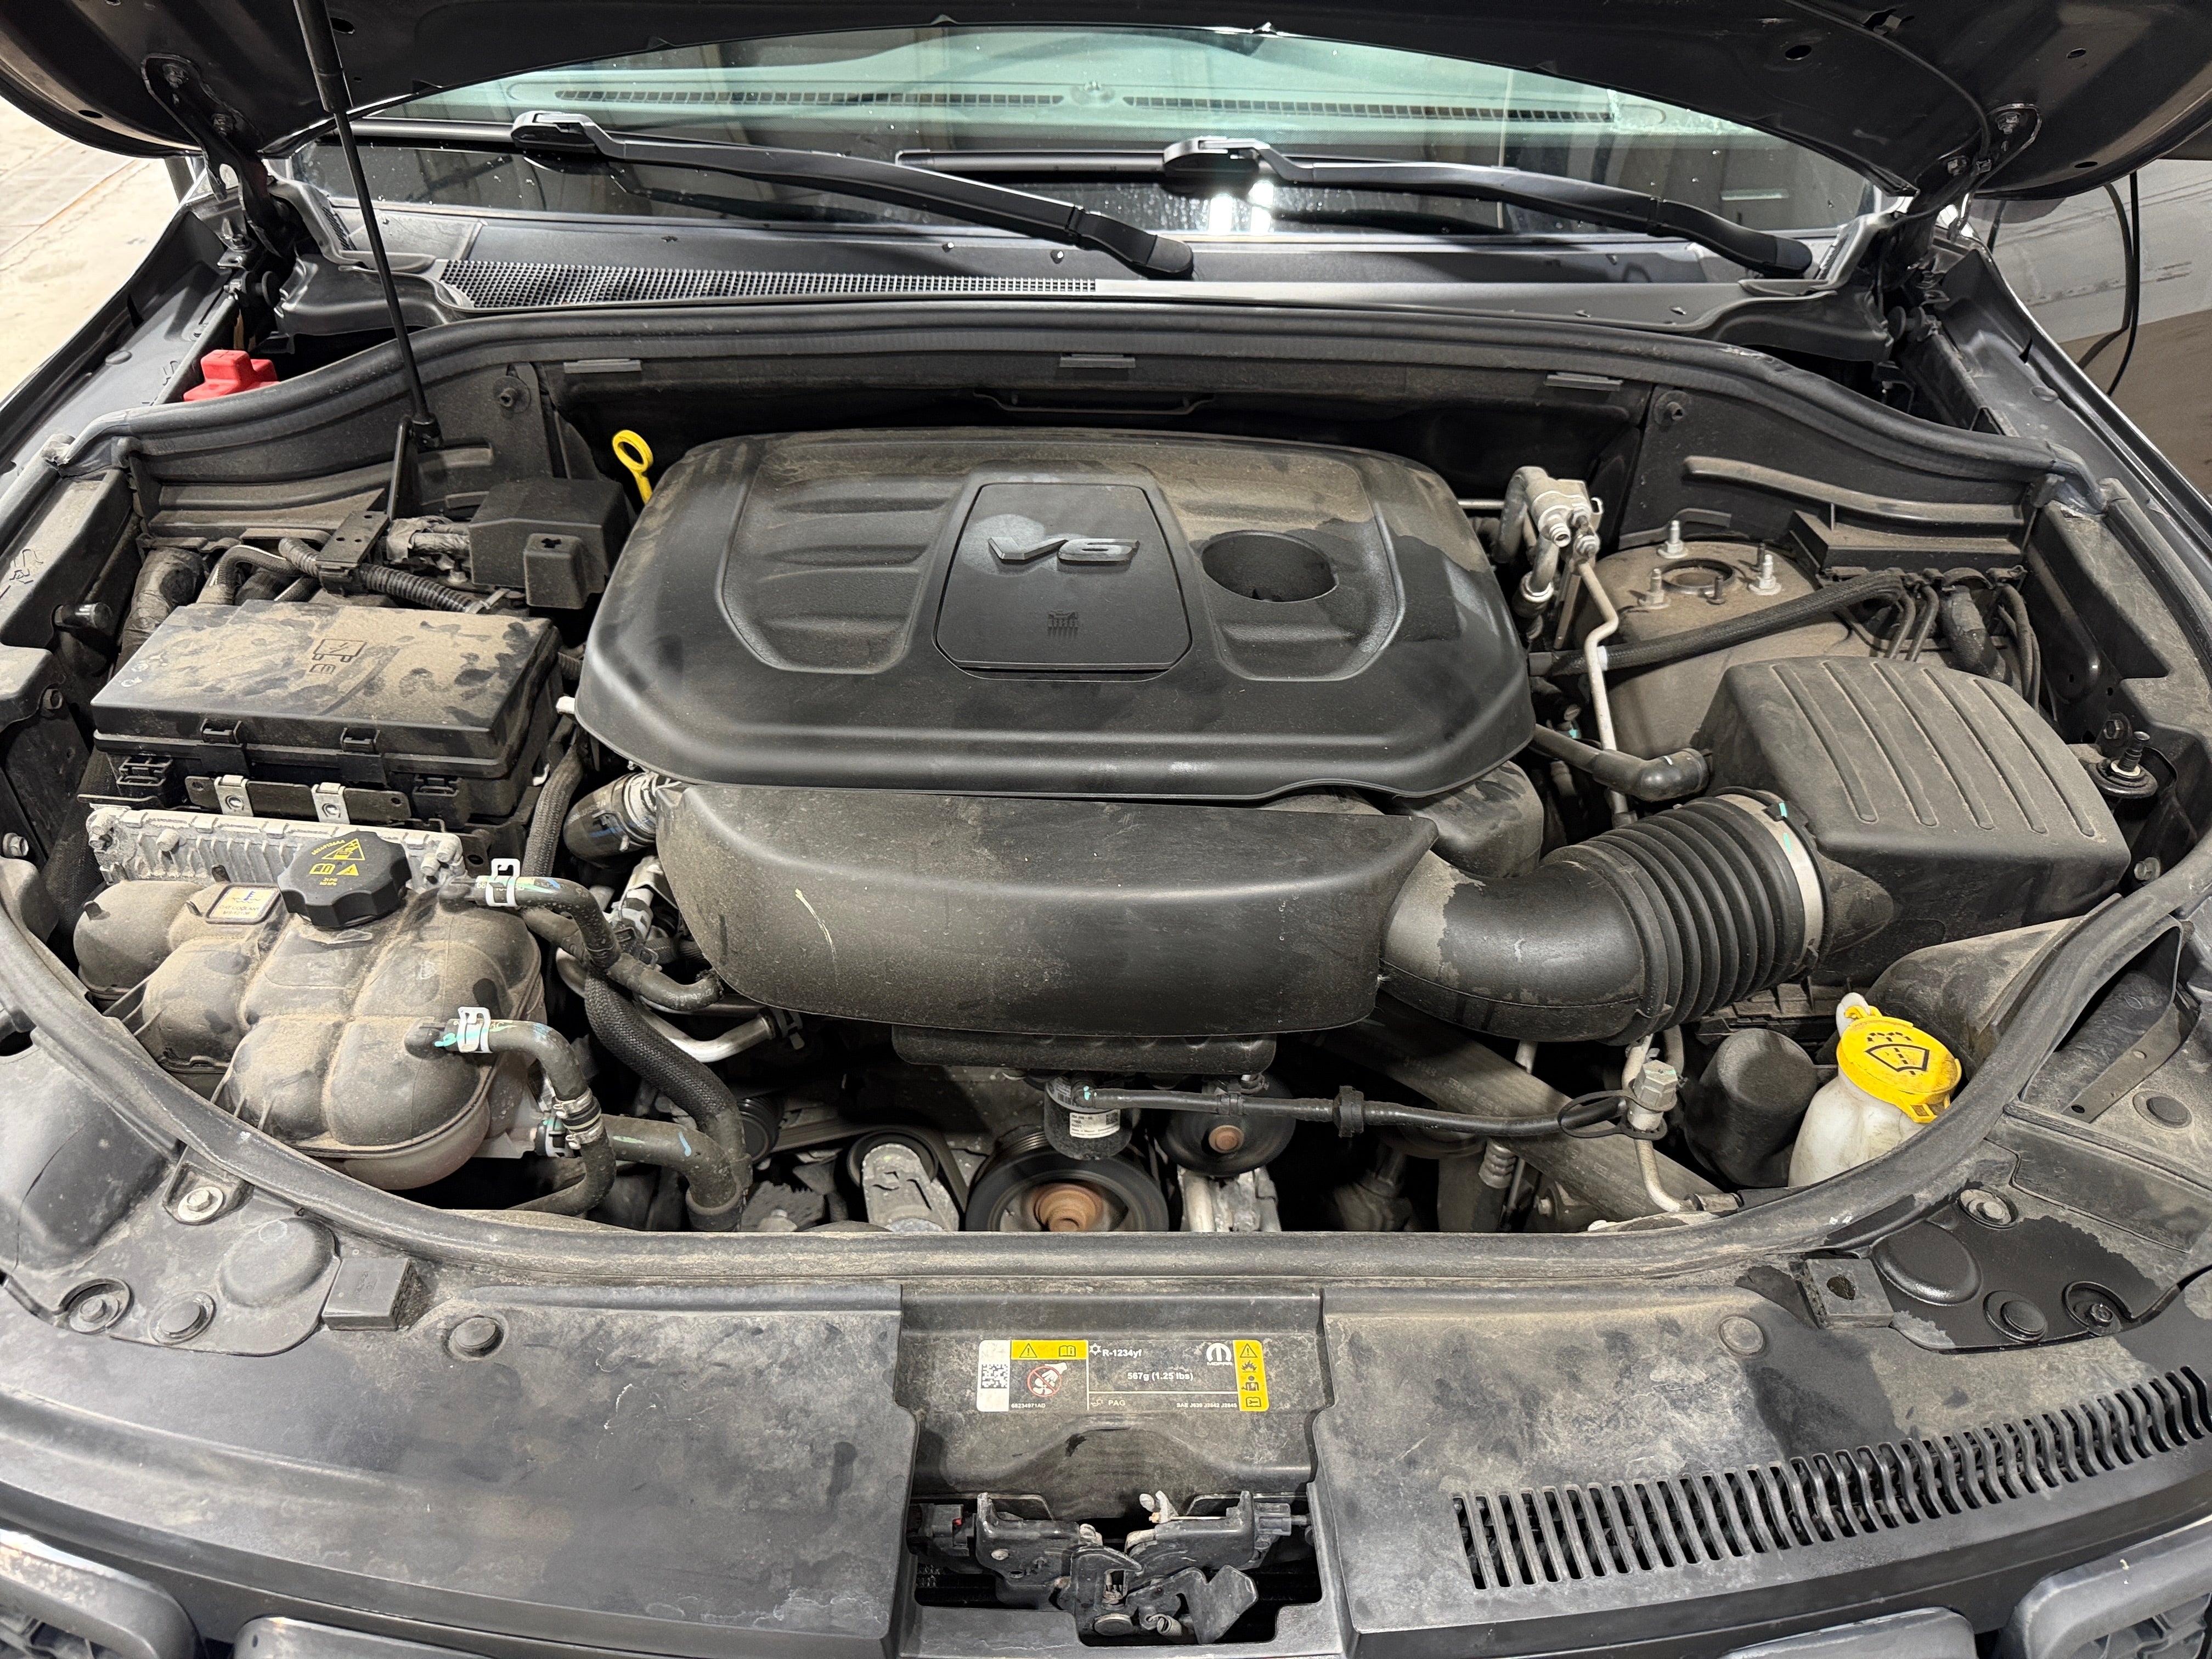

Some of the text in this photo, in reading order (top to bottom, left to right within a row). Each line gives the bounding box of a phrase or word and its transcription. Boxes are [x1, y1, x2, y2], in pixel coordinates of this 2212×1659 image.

[988, 537, 1140, 562] V6
[1102, 1349, 1142, 1358] R-1234yf
[1127, 1372, 1194, 1381] 567g (1.25 lbs)
